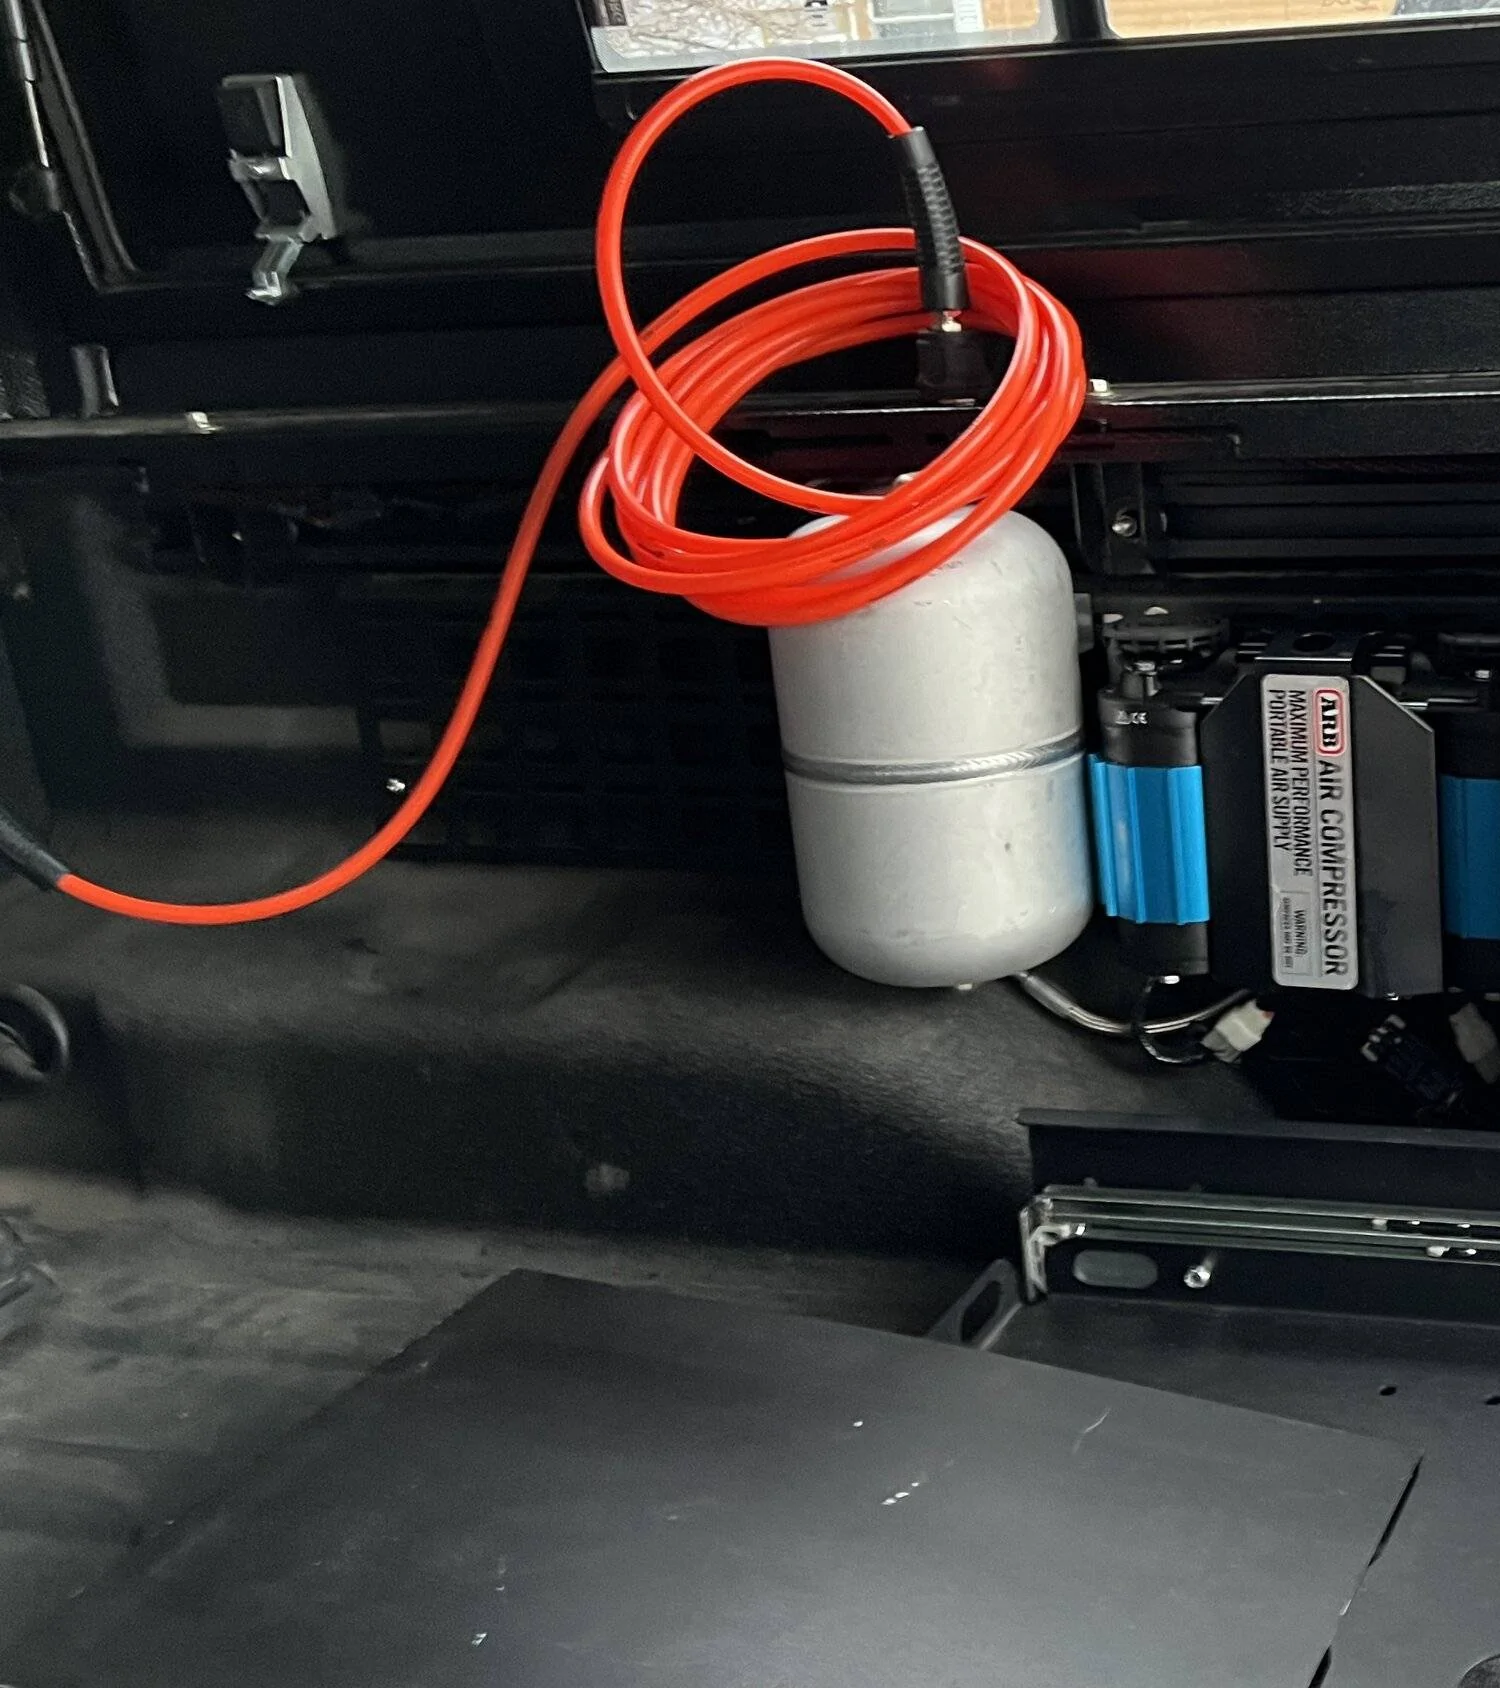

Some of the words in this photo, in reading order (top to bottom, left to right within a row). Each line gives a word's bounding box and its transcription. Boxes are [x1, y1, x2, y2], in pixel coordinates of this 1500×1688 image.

[1267, 689, 1290, 764] PORTABLE
[1289, 689, 1310, 763] MAXIMUM
[1319, 696, 1340, 748] ARB
[1271, 768, 1290, 792] AIR
[1319, 760, 1345, 800] AIR
[1272, 796, 1293, 852] SUPPLY
[1291, 767, 1313, 876] PERFORMANCE
[1320, 809, 1349, 977] COMPRESSOR
